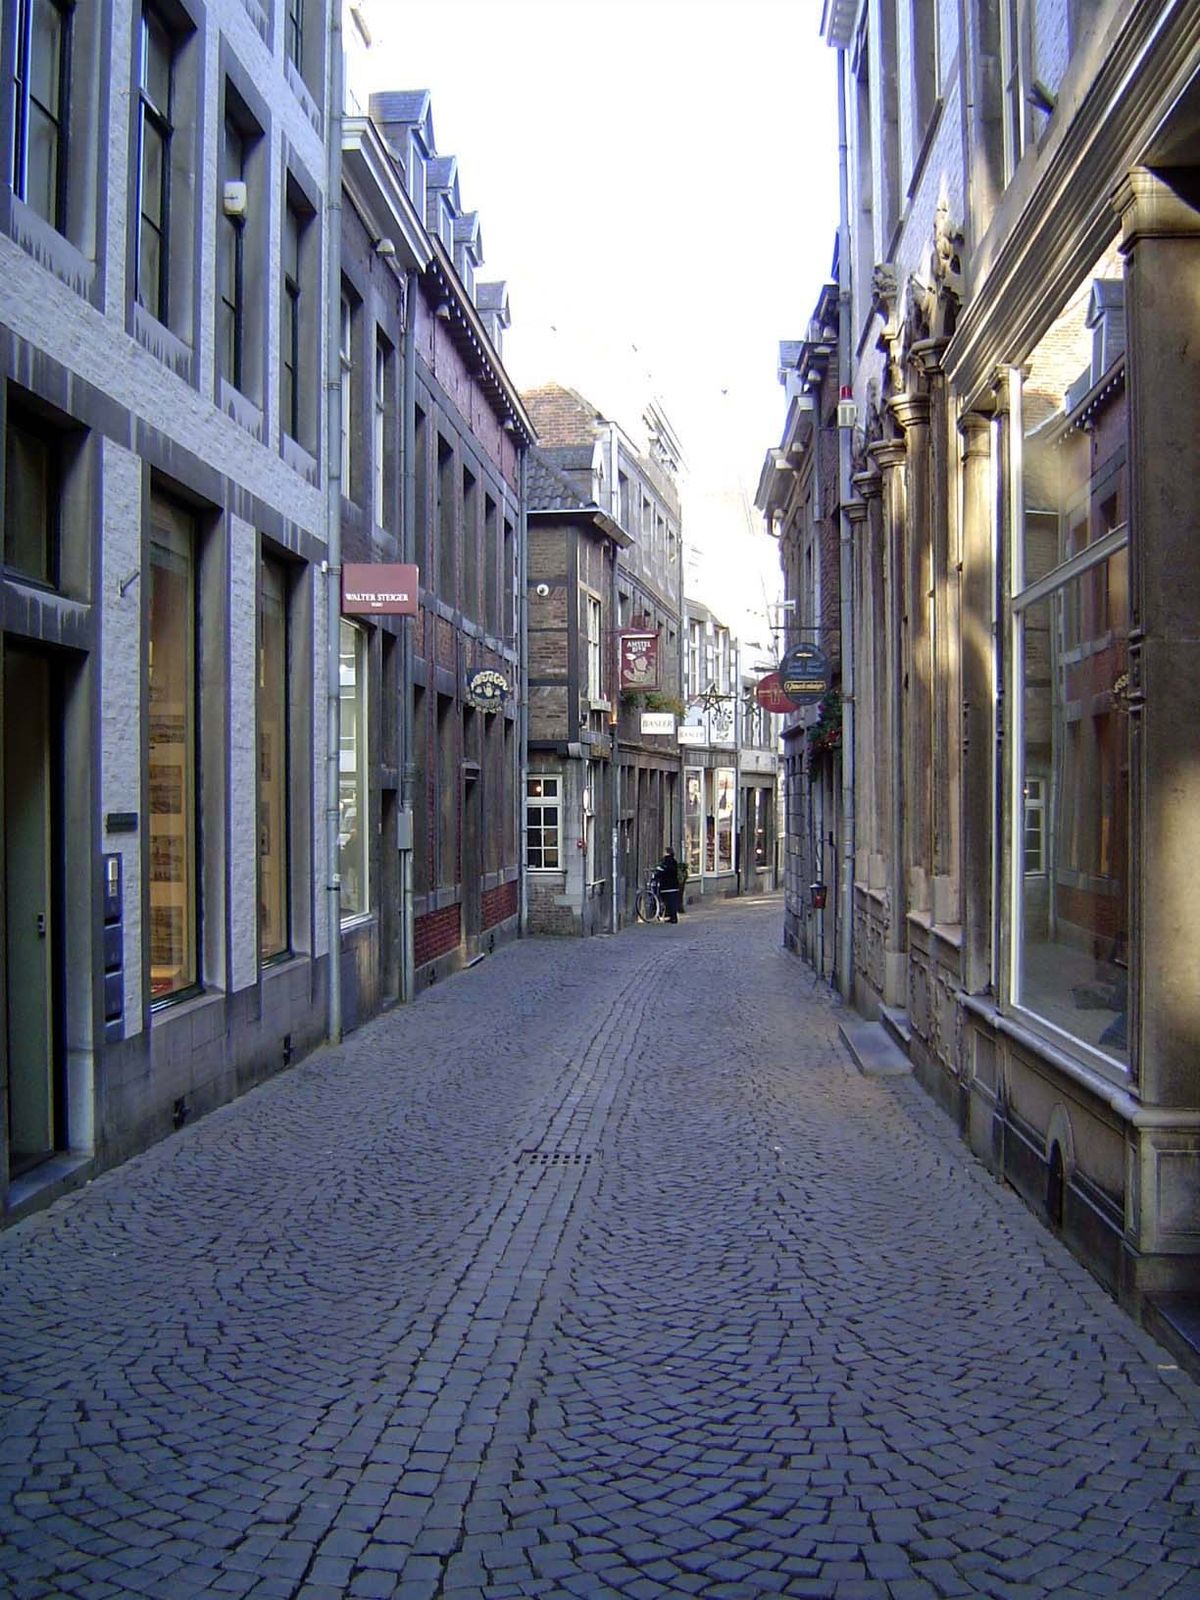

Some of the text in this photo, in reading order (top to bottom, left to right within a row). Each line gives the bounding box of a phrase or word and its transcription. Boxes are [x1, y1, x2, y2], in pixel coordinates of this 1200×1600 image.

[345, 593, 409, 602] WALTER STEIGER
[627, 640, 652, 648] AMSTEL
